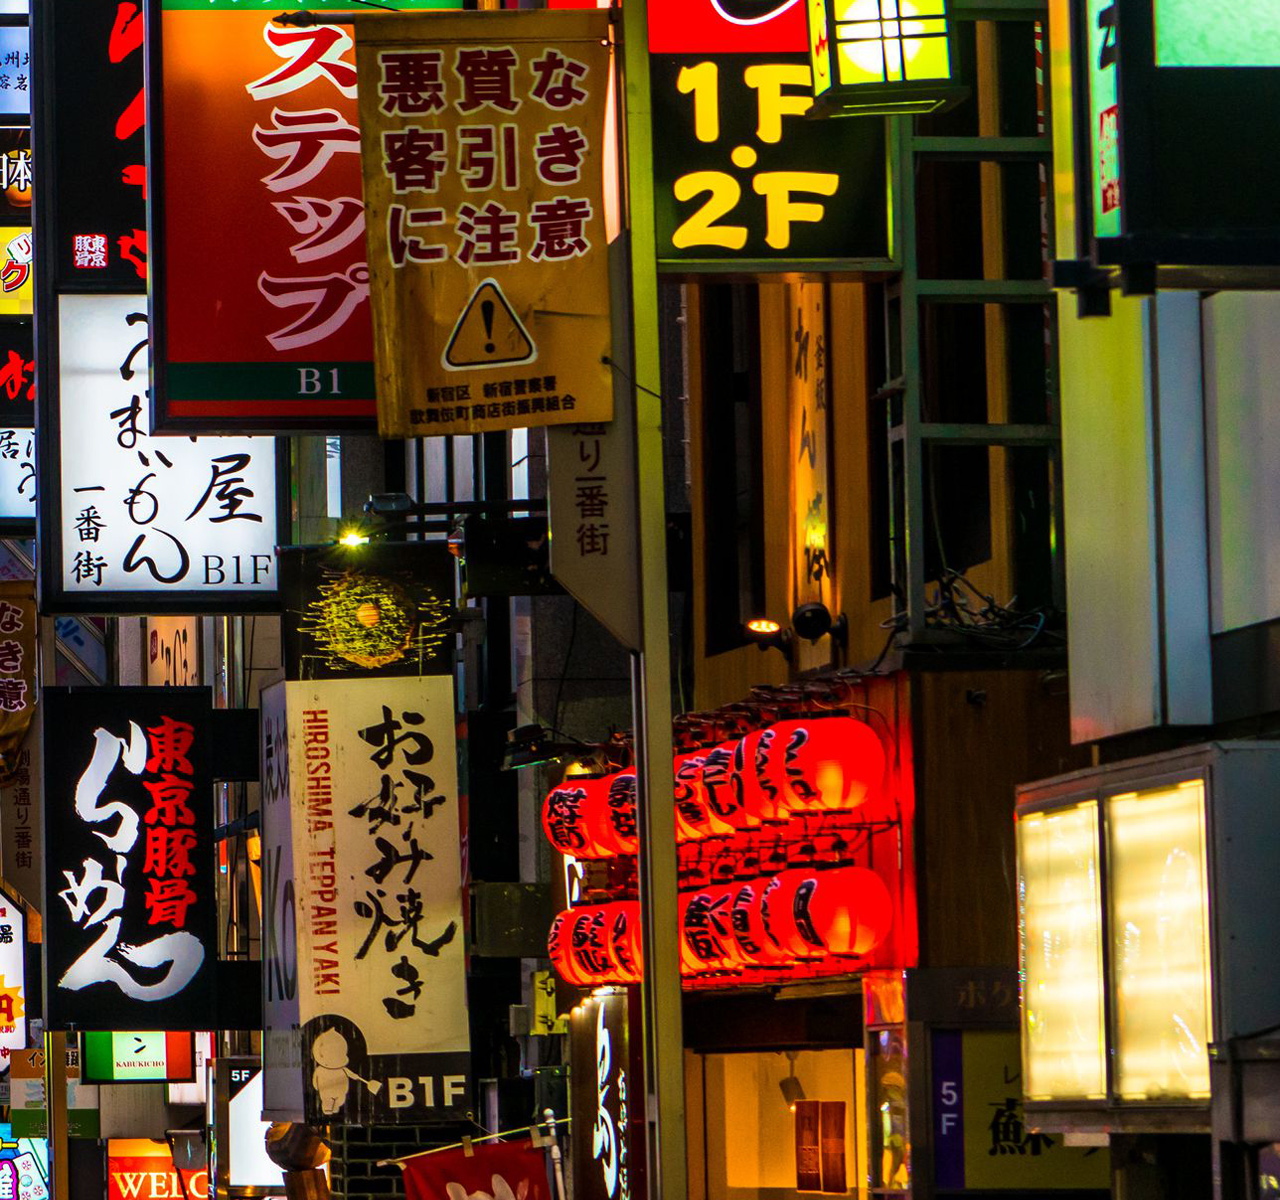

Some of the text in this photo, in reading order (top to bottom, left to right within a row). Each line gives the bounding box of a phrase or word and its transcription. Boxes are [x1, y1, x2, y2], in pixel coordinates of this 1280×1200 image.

[379, 47, 590, 118] 悪質な
[381, 122, 588, 197] 客引き
[387, 196, 593, 270] に注意
[672, 171, 840, 250] 2F
[409, 394, 577, 425] 歌舞伎町商店街振興組合
[427, 375, 557, 403] 新宿区 新宿警察署
[70, 485, 109, 586] 一番街
[201, 552, 273, 586] B1F
[142, 715, 199, 929] 東京豚骨
[301, 708, 341, 997] HIROSHIMA TEPPAN YAKI
[347, 704, 459, 1020] お好み焼き
[114, 1059, 166, 1069] KABUKICHO
[230, 1070, 251, 1083] 5F
[387, 1075, 467, 1110] B1F
